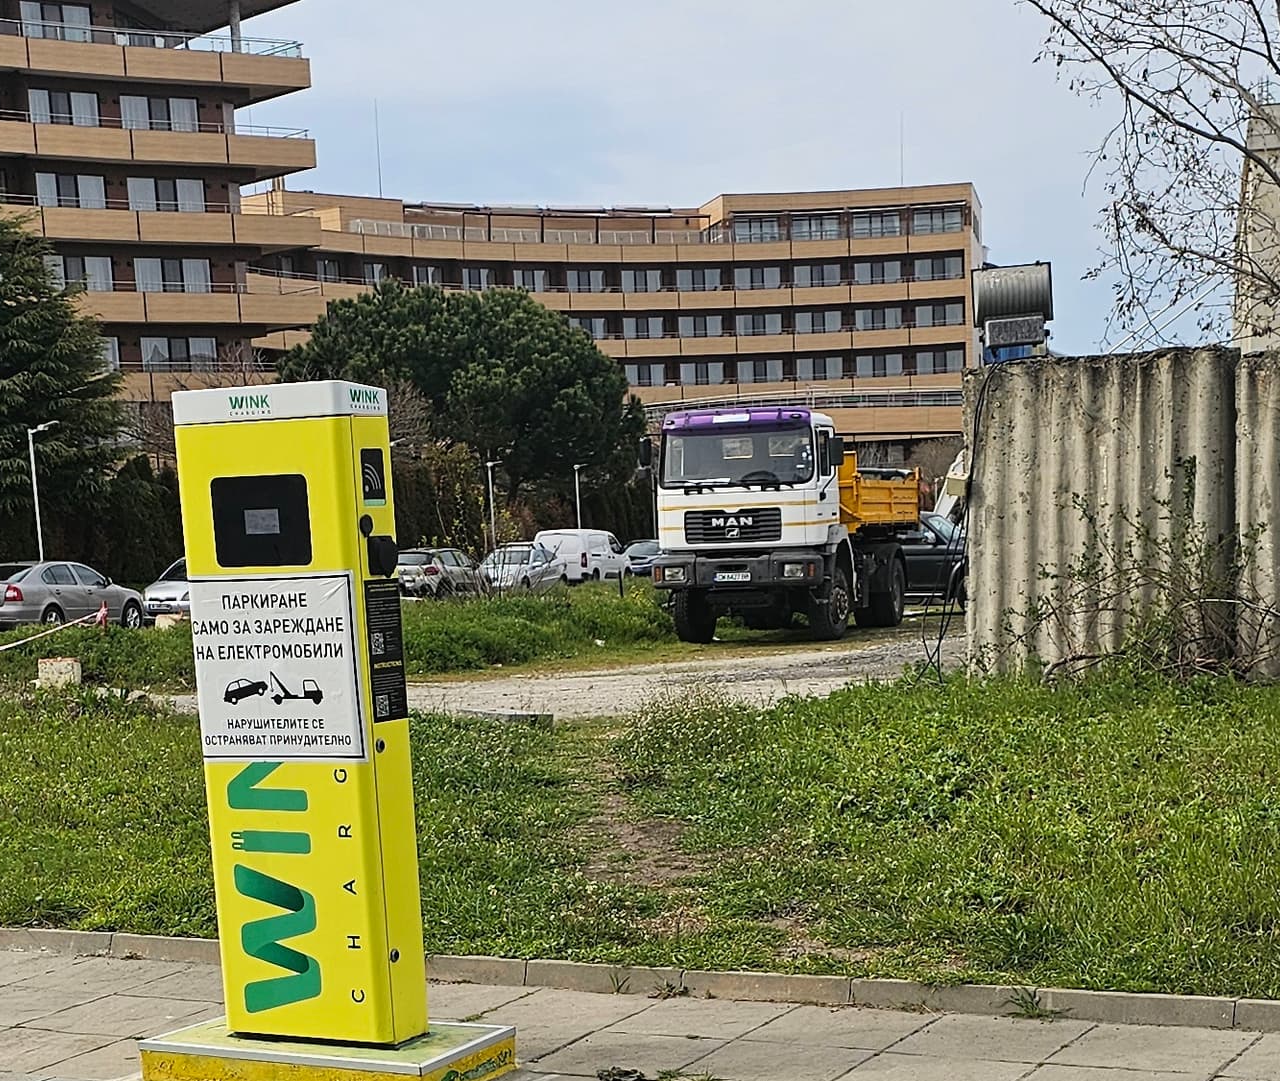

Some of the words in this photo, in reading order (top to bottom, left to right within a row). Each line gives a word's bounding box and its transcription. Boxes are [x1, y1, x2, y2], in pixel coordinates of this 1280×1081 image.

[229, 394, 271, 410] WINK
[349, 388, 380, 405] WINK
[711, 516, 753, 527] MAN
[221, 592, 308, 610] ПАРКИРАНЕ
[192, 619, 229, 636] САМО
[232, 619, 252, 635] ЗА
[254, 616, 345, 636] ЗАРЕЖДАНЕ
[196, 645, 215, 660] НА
[218, 642, 344, 660] ЕЛЕКТРОМОБИЛИ
[227, 718, 310, 730] НАРУШИТЕЛИТЕ
[311, 718, 325, 729] СЕ
[204, 734, 268, 746] ОСТРАНЯВАТ
[269, 734, 352, 748] ПРИНУДИТЕЛНО
